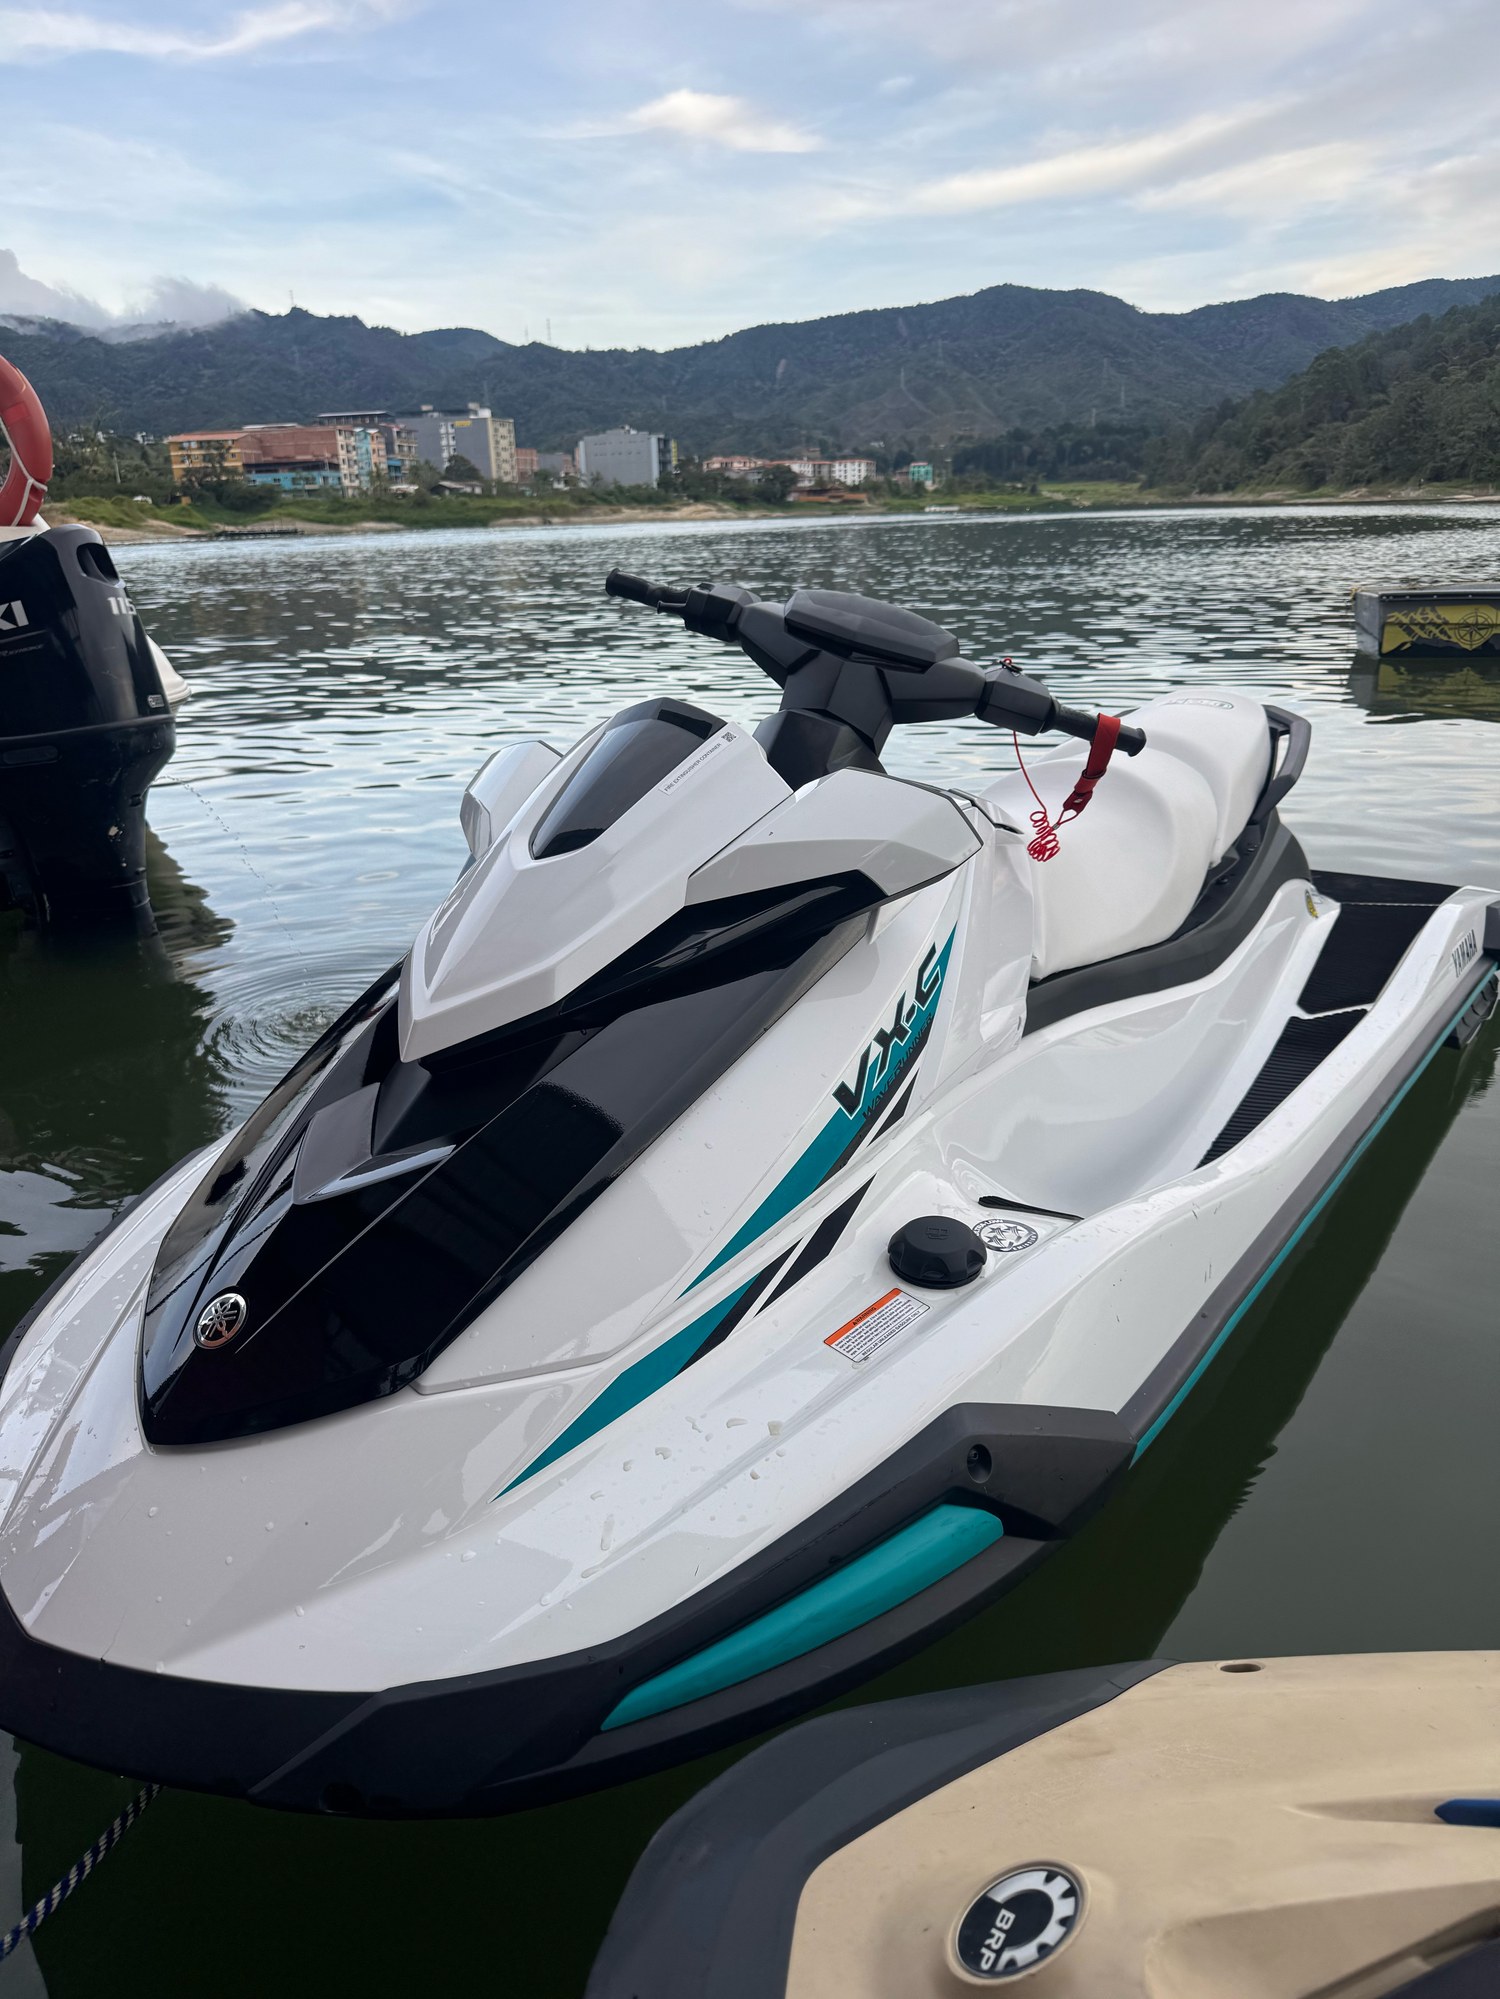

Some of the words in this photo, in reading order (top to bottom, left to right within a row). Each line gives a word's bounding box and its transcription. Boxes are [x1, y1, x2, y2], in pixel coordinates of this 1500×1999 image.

[107, 597, 137, 616] 115
[663, 781, 675, 792] FIRE
[673, 759, 701, 784] EXTINGUISHER
[699, 742, 722, 761] CONTAINER
[980, 1908, 1016, 1971] BRP
